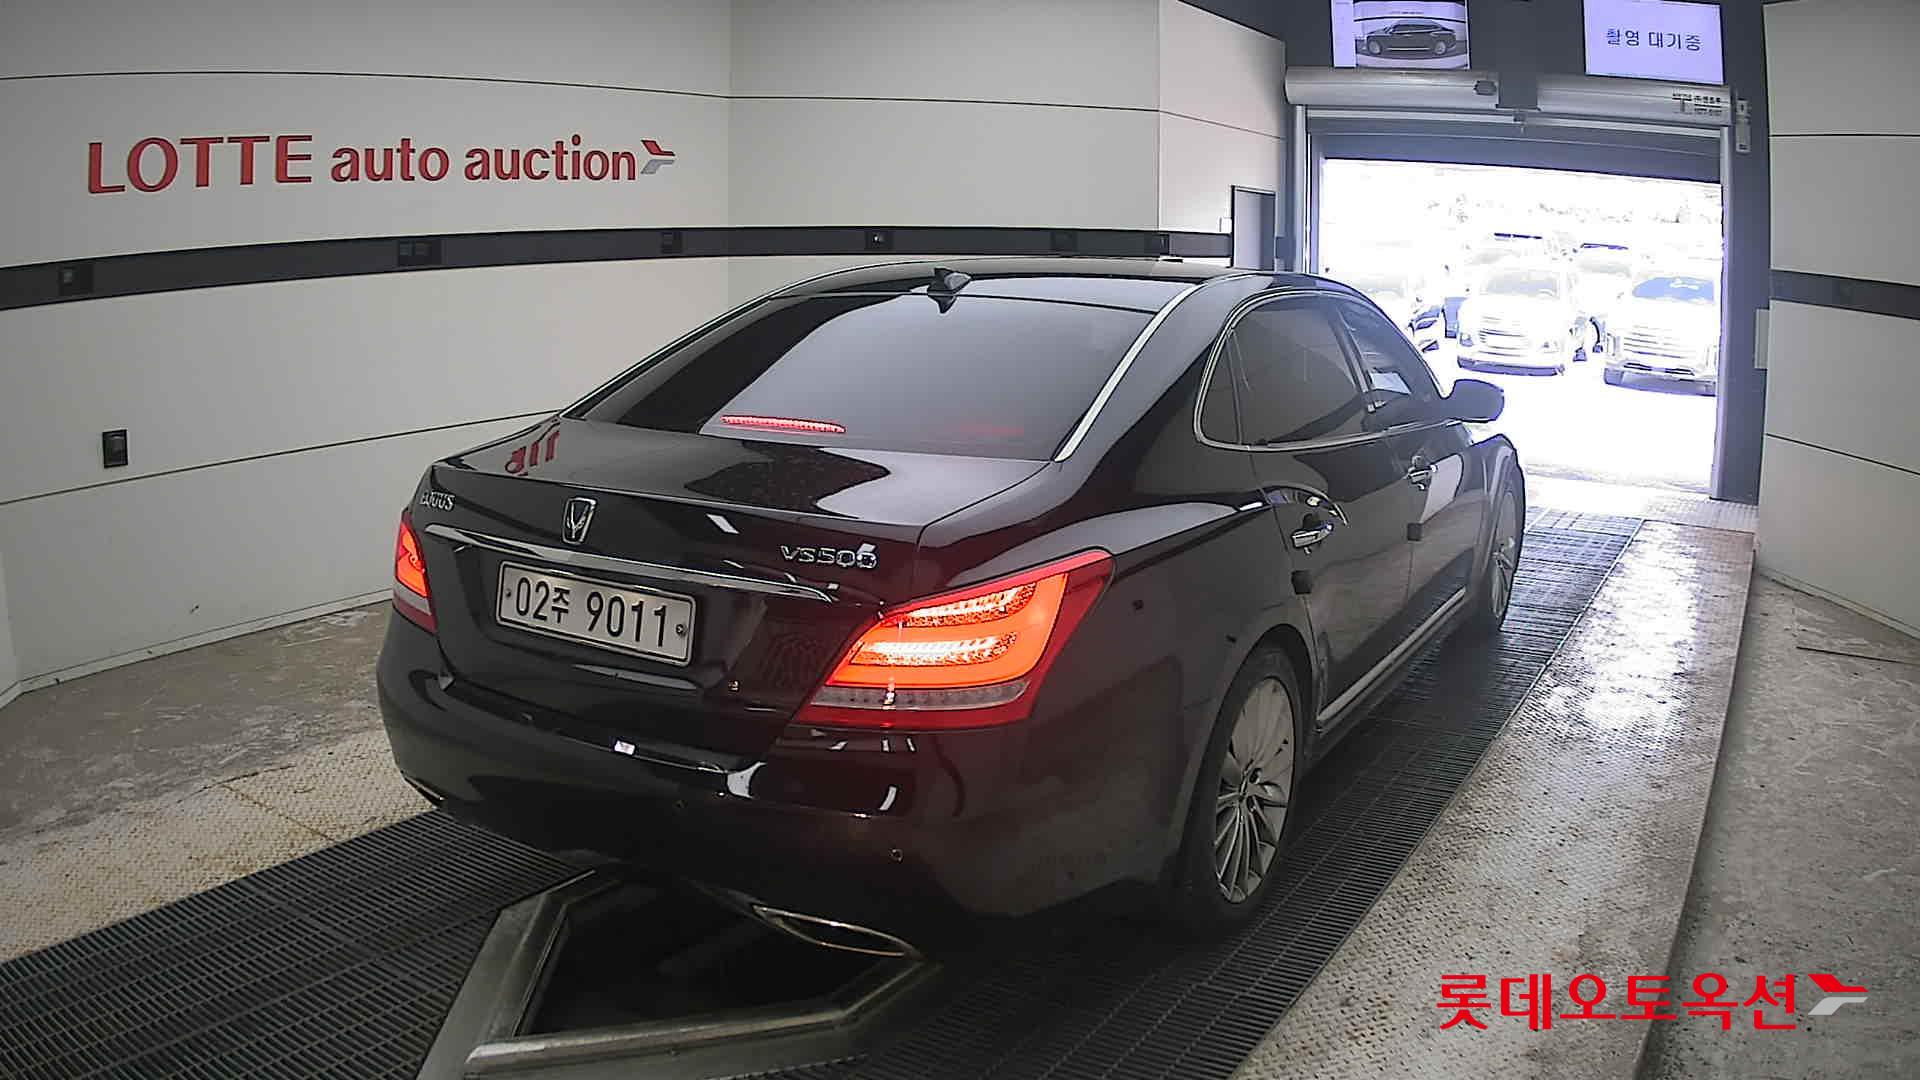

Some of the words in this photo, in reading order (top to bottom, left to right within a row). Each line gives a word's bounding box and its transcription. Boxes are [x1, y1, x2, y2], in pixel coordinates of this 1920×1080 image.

[1606, 28, 1640, 47] 촬영
[1647, 31, 1702, 52] 대기중
[87, 135, 313, 194] LOTTE
[330, 137, 450, 183] auto
[463, 134, 638, 182] auction
[515, 576, 571, 624] 02주
[586, 591, 668, 648] 9011
